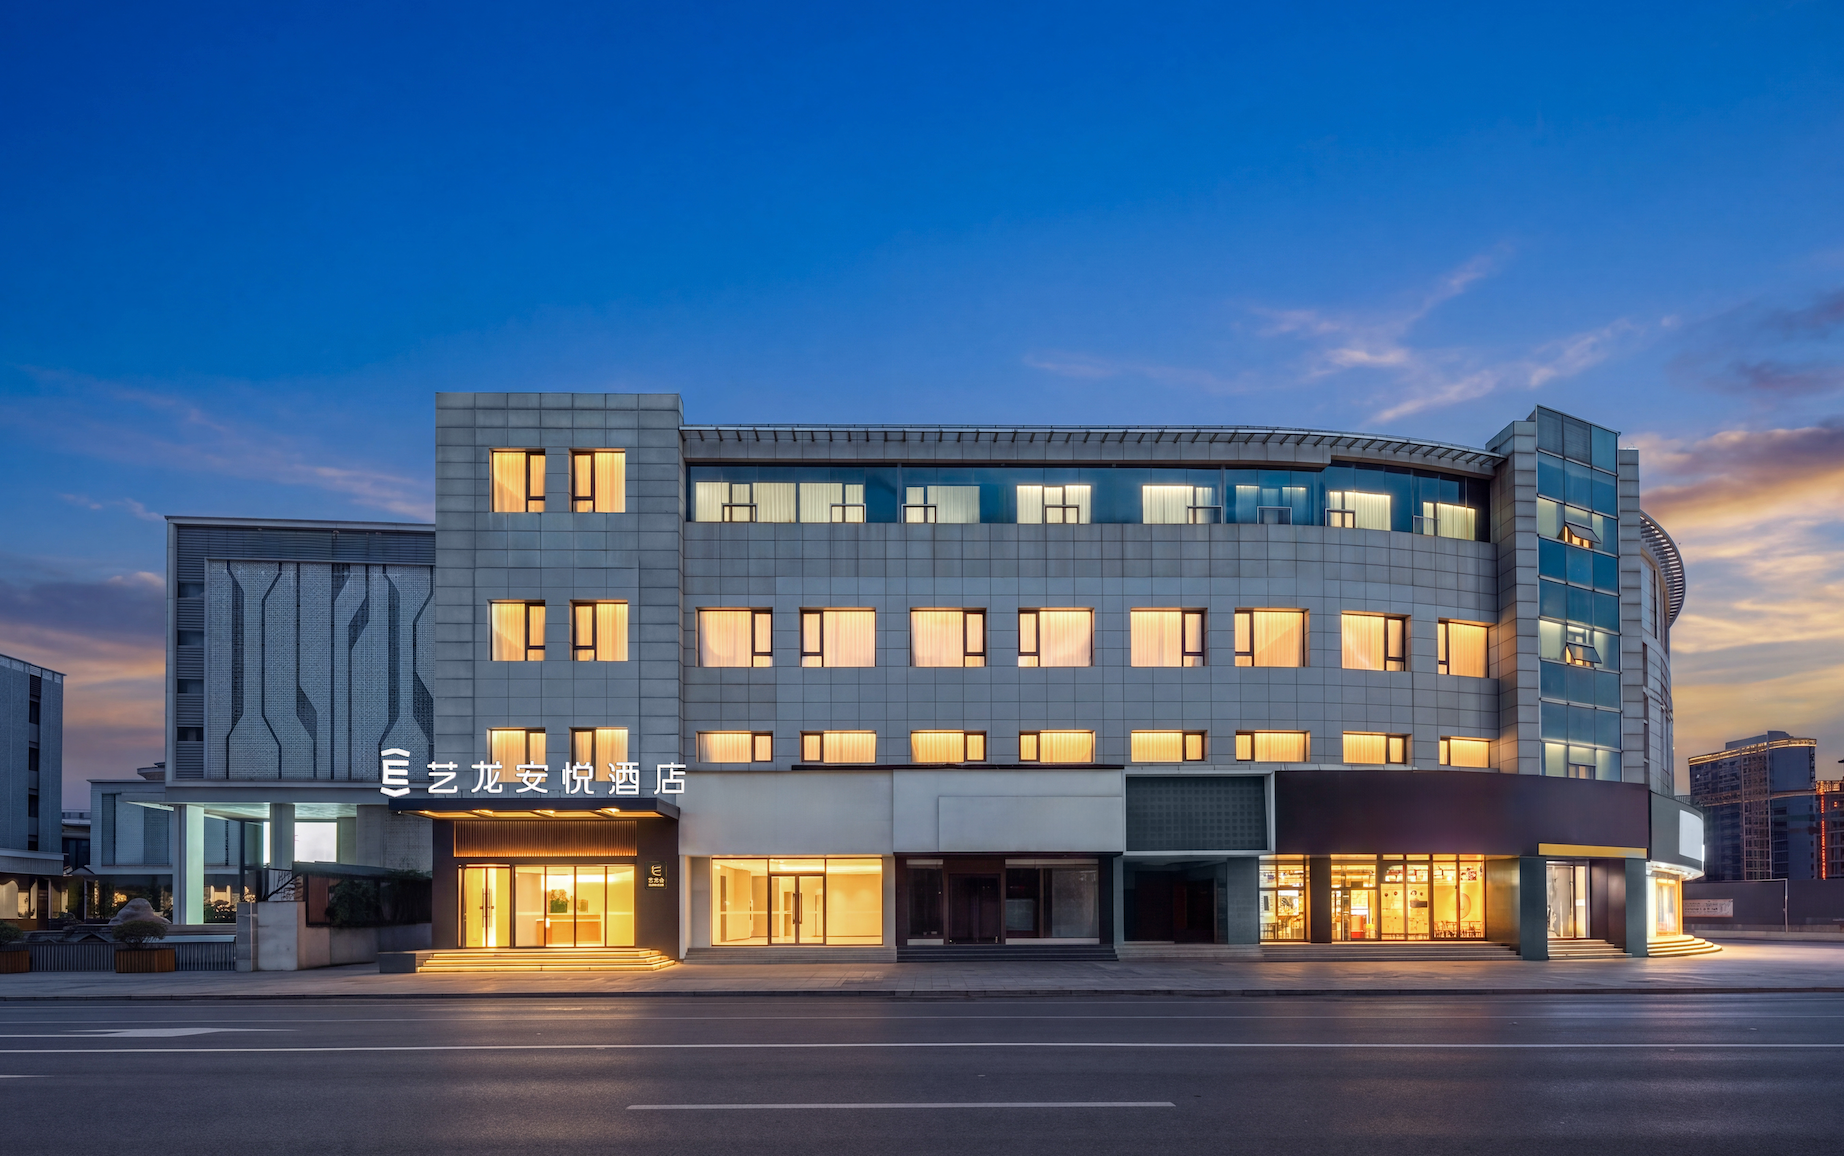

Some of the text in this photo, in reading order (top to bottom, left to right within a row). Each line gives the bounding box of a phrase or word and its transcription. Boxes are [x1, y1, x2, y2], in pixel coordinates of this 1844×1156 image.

[426, 760, 687, 796] 艺龙安悦酒店
